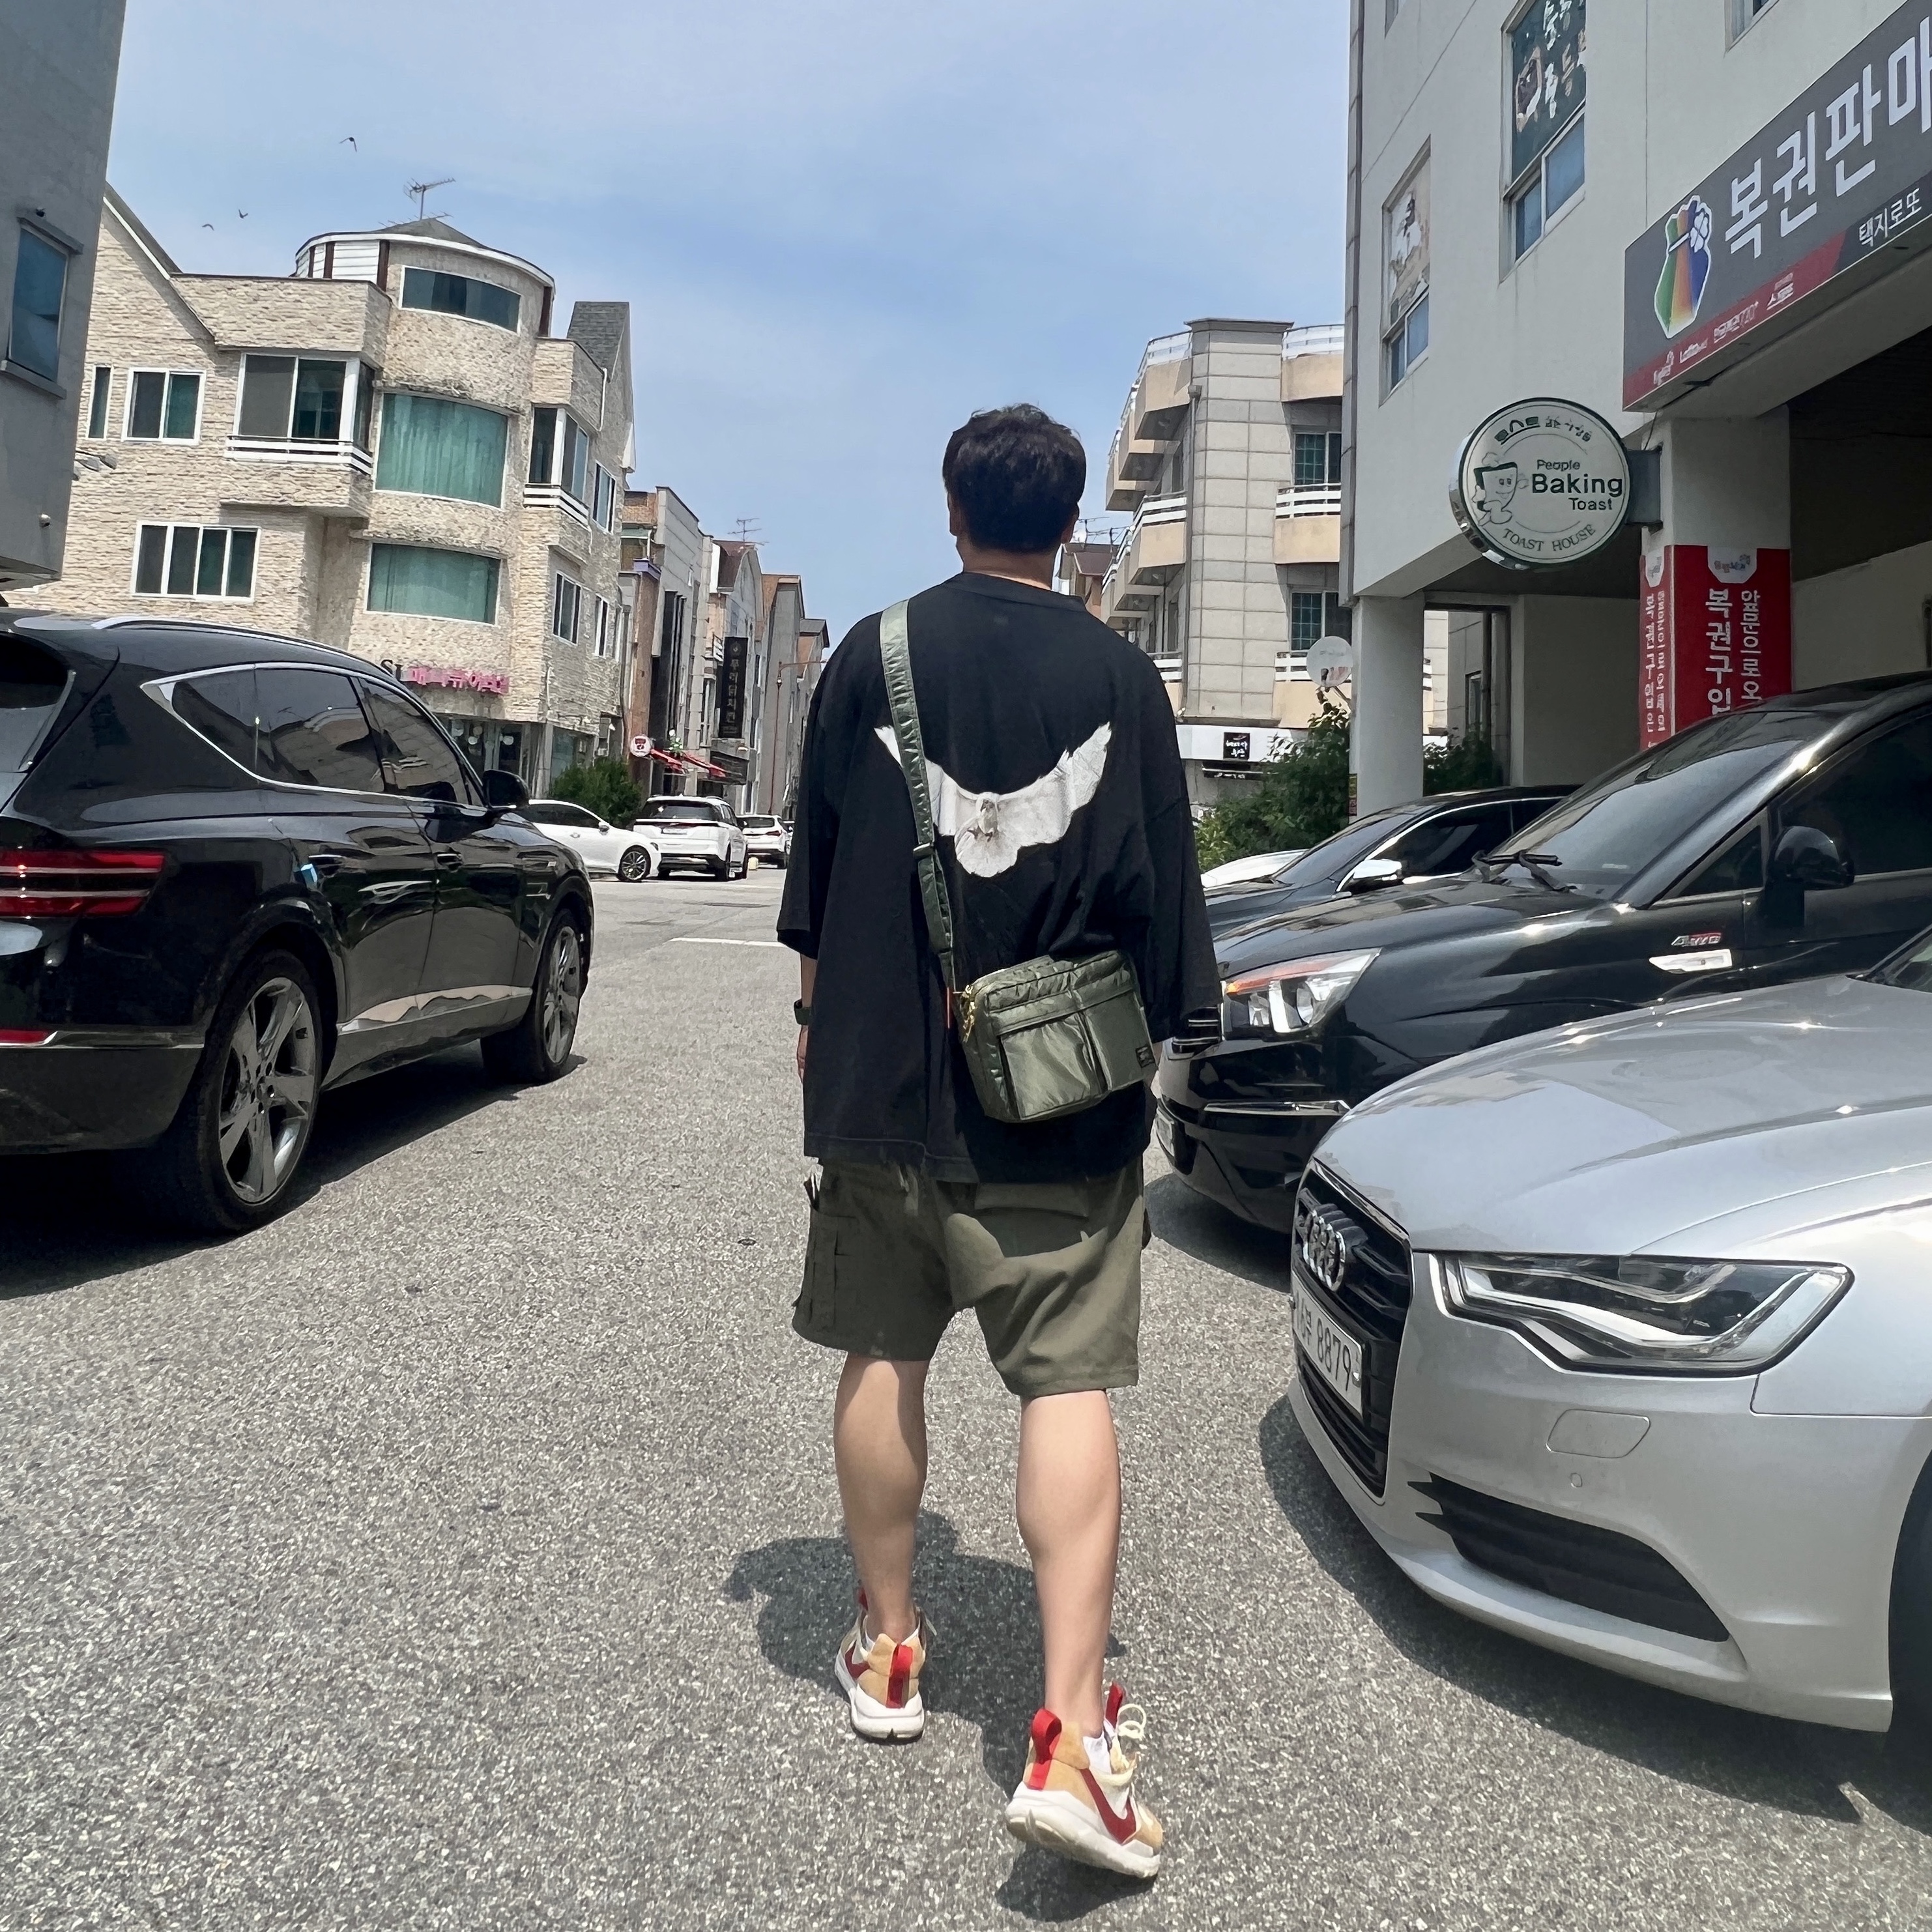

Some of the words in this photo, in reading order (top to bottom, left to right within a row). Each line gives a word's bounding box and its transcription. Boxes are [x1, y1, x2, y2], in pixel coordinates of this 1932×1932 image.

[1859, 188, 1922, 247] 택지로또
[1536, 459, 1580, 472] People
[1532, 474, 1622, 497] Baking
[1568, 497, 1613, 510] Toast
[1503, 528, 1544, 551] TOAST
[1552, 524, 1596, 551] HOUSE
[1318, 1318, 1351, 1392] 8879
